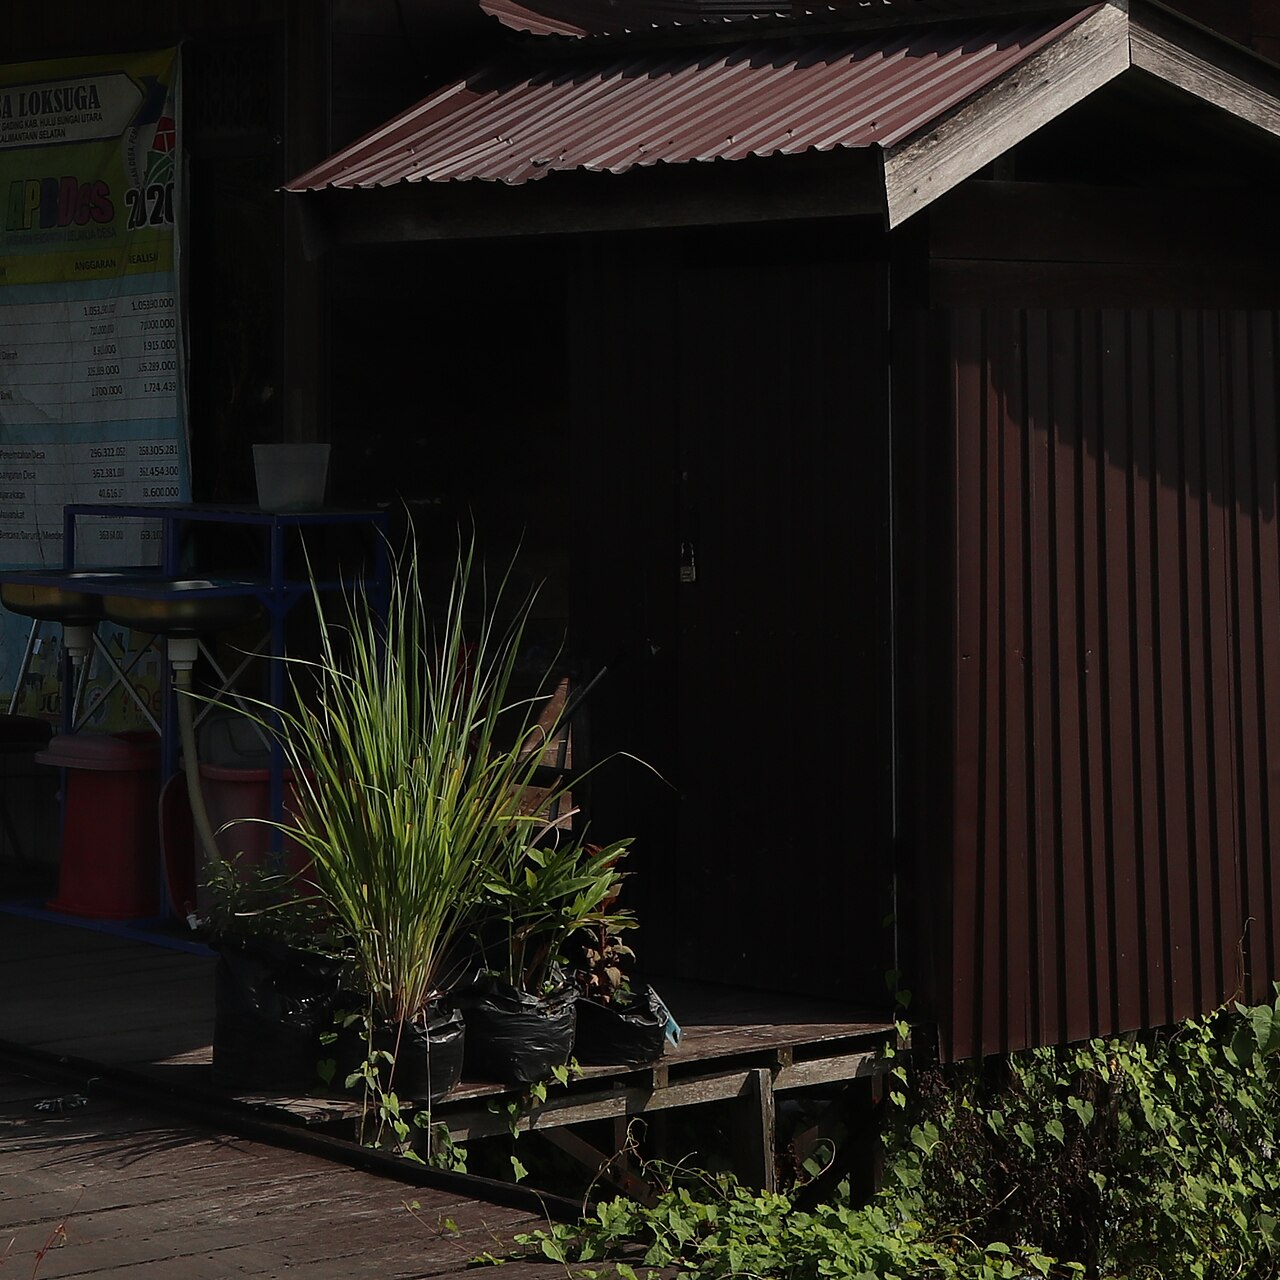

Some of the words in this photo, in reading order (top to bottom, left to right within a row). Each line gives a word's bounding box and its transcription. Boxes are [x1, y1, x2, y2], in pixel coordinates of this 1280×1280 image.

[19, 85, 101, 117] LOKSUGA
[1, 120, 23, 132] GADING
[24, 119, 38, 129] KAB.
[40, 117, 56, 127] HULU
[57, 115, 80, 125] SUNGAI
[81, 113, 103, 123] UTARA
[39, 128, 66, 139] SELATAN
[6, 176, 114, 231] APBDes
[75, 260, 116, 271] ANGGARAN
